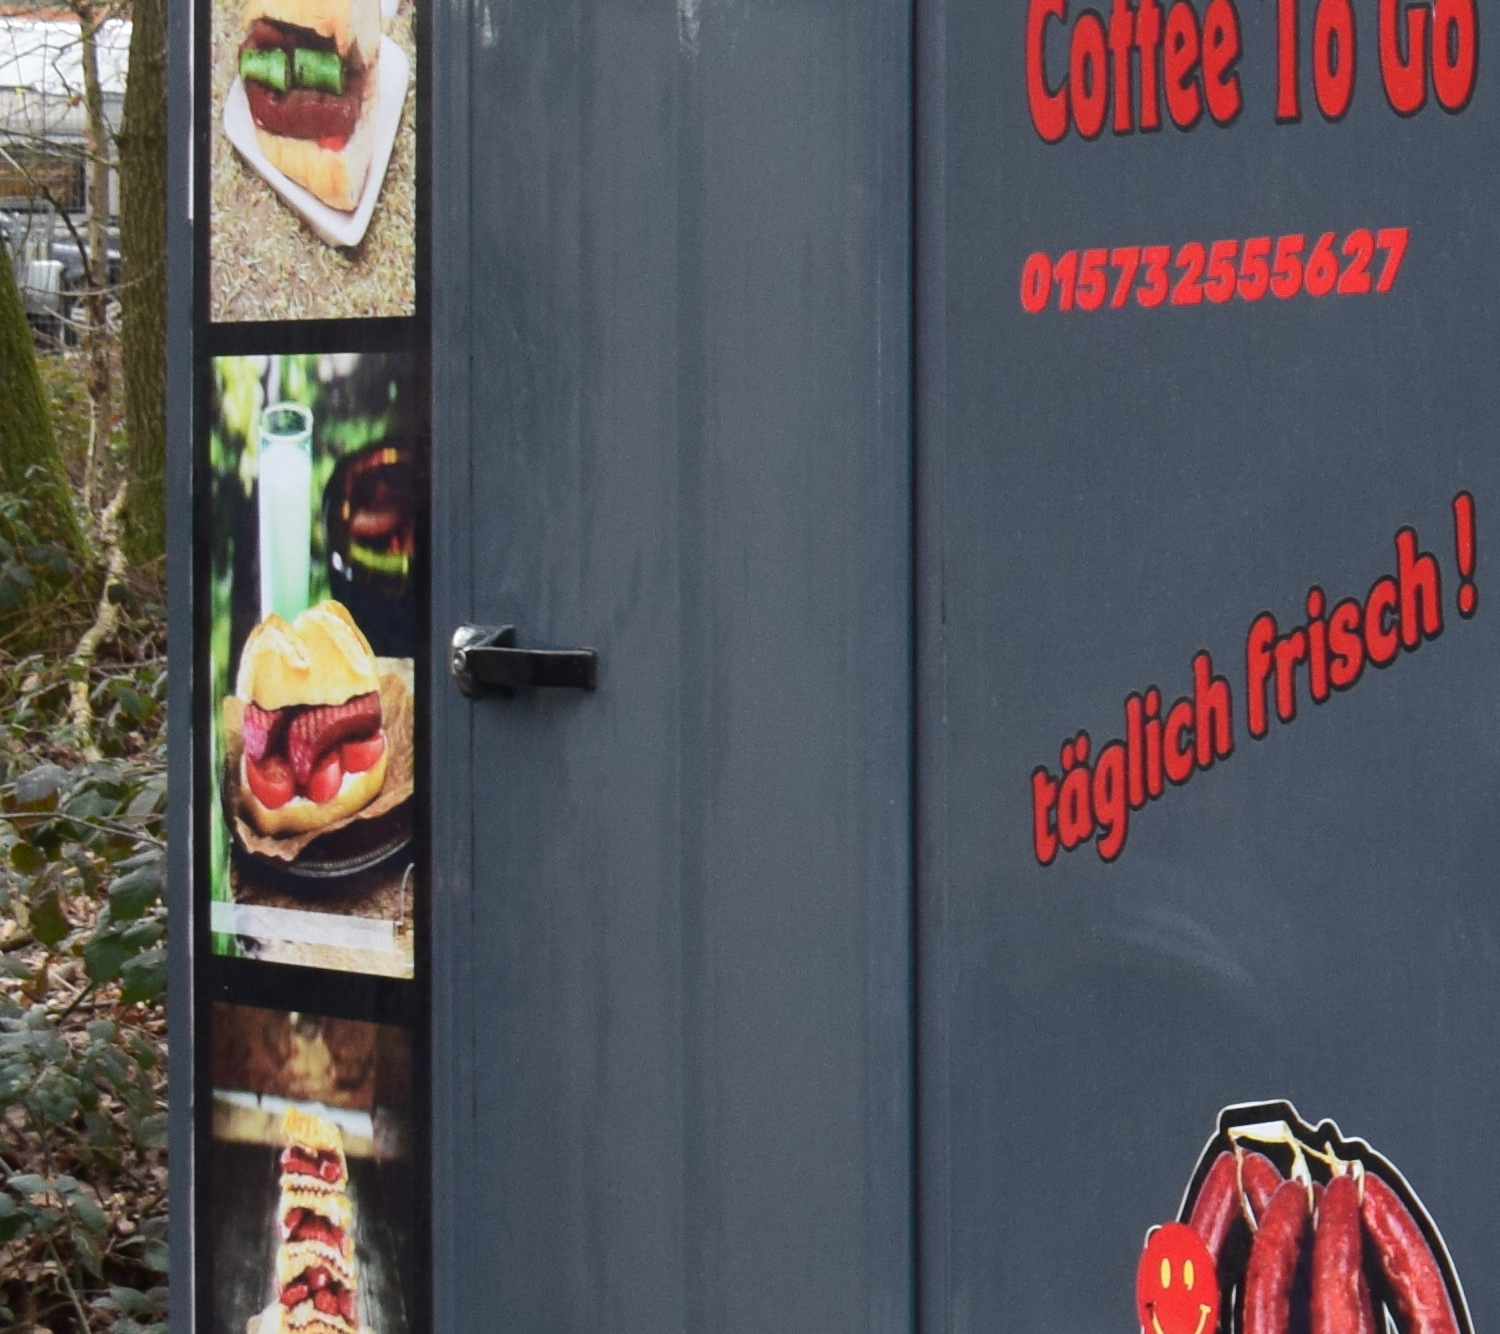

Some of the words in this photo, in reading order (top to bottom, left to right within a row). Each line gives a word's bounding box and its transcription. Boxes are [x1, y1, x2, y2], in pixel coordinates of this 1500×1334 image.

[1020, 228, 1410, 313] 015732555627
[1029, 647, 1233, 868] täglich
[1245, 524, 1446, 740] frisch
[1451, 491, 1481, 618] !
